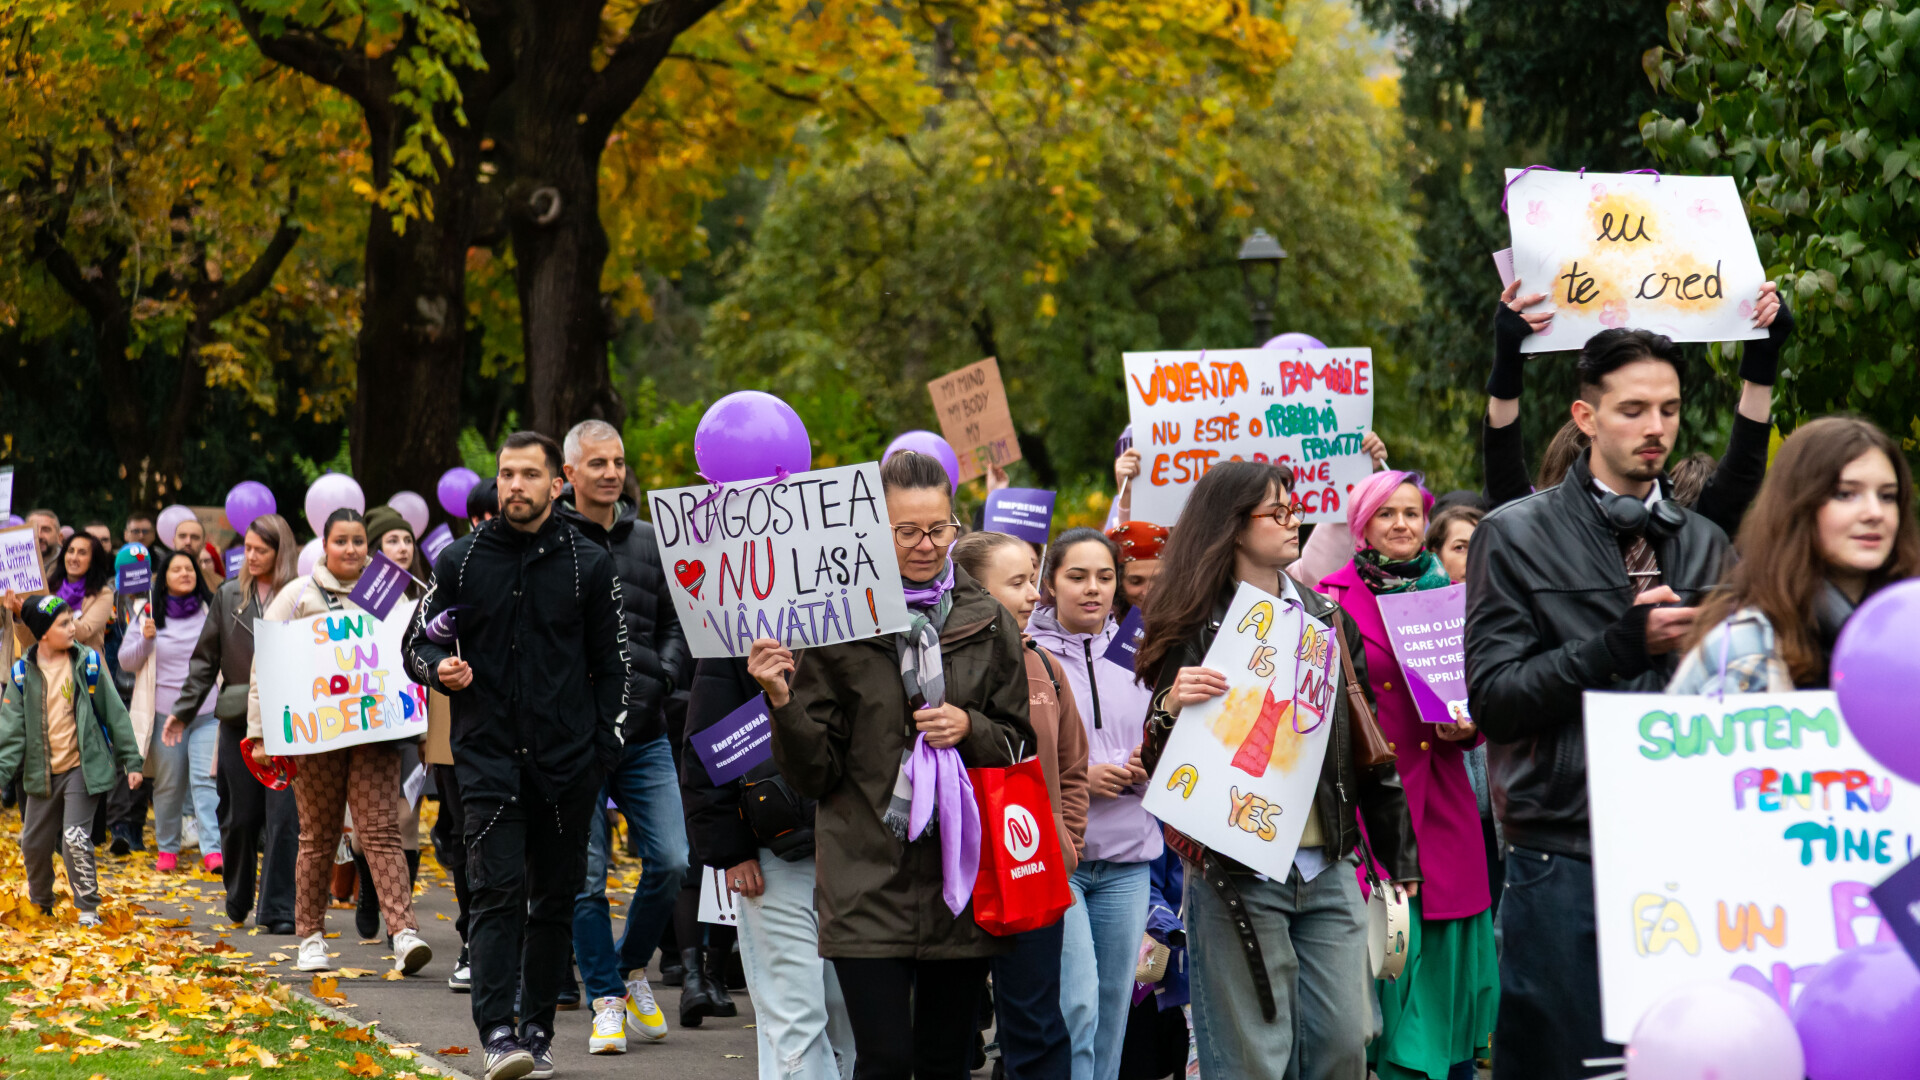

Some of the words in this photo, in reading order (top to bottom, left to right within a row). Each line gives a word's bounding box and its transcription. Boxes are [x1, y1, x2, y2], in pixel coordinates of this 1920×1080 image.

[1596, 212, 1652, 242] eu
[1561, 261, 1600, 304] te
[1635, 259, 1723, 300] cred
[957, 368, 986, 393] MIND
[1279, 357, 1369, 397] FAMILIE
[962, 390, 990, 418] BODY
[1152, 421, 1181, 446] NU
[1194, 412, 1240, 442] ESTE
[1249, 417, 1263, 437] O
[654, 469, 880, 548] DRAGOSTEA
[718, 536, 776, 606] NU
[791, 532, 881, 596] LASĂ
[312, 614, 377, 645] SUNT
[1237, 600, 1274, 641] A
[1397, 622, 1431, 635] VREM
[1433, 621, 1443, 632] O
[334, 642, 379, 671] UN
[1403, 639, 1435, 652] CARE
[1435, 634, 1464, 649] VICT
[1247, 638, 1278, 678] IS
[1299, 669, 1335, 714] NOT
[1406, 656, 1438, 668] SUNT
[313, 670, 389, 701] ADULT
[1638, 704, 1841, 761] SUNTEM
[1167, 763, 1199, 800] A
[1227, 785, 1284, 843] YES
[1733, 767, 1893, 813] PENTRU
[1010, 861, 1046, 880] NEMIRA
[1633, 881, 1701, 958] FĂ
[1716, 899, 1787, 952] UN
